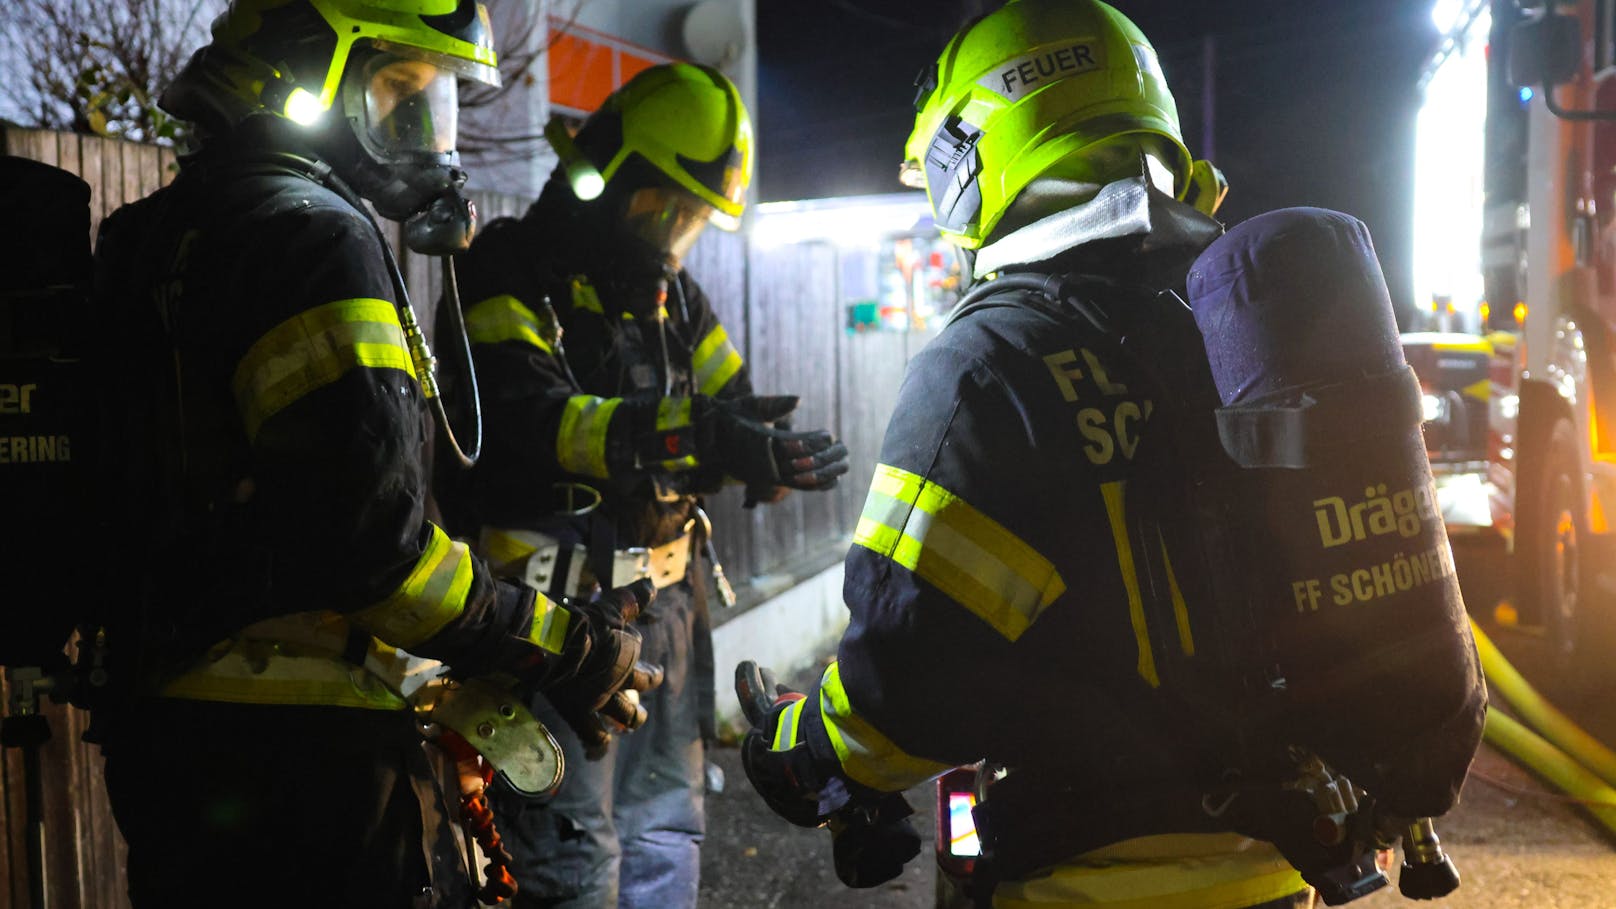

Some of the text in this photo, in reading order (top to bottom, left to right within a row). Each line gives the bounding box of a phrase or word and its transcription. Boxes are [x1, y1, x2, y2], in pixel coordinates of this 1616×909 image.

[1001, 44, 1095, 93] FEUER
[0, 383, 38, 415] er
[1292, 579, 1323, 613] FF
